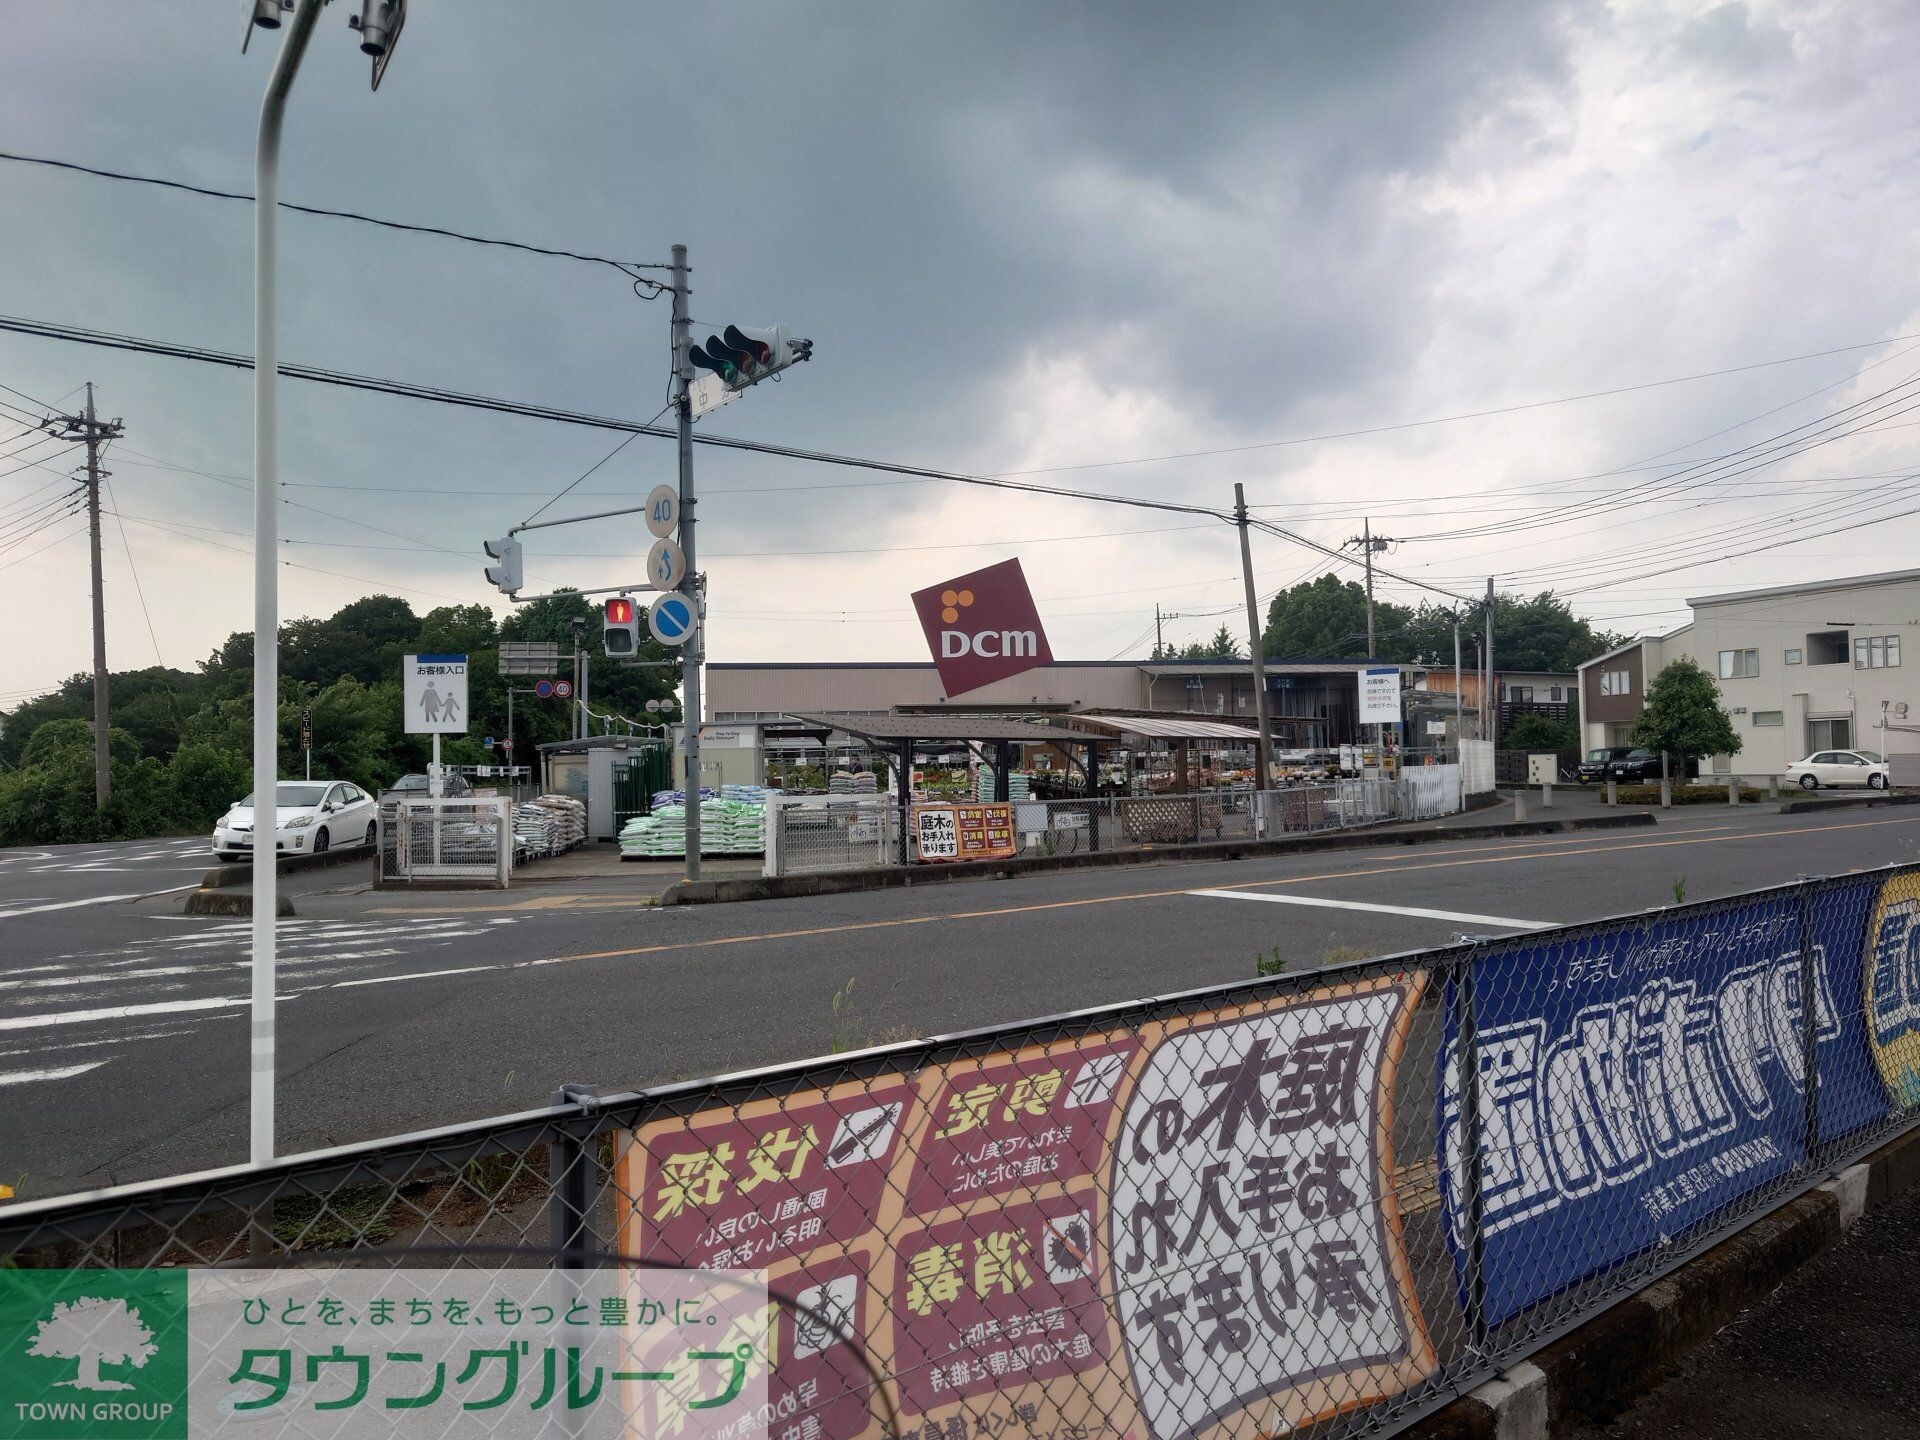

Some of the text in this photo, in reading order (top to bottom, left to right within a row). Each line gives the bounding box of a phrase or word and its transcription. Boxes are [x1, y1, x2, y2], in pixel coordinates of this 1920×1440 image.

[653, 498, 672, 522] 40
[417, 665, 464, 675] お客様入口
[920, 814, 954, 831] 庭木の
[921, 831, 955, 841] お手入れ
[922, 843, 956, 854] 承ります
